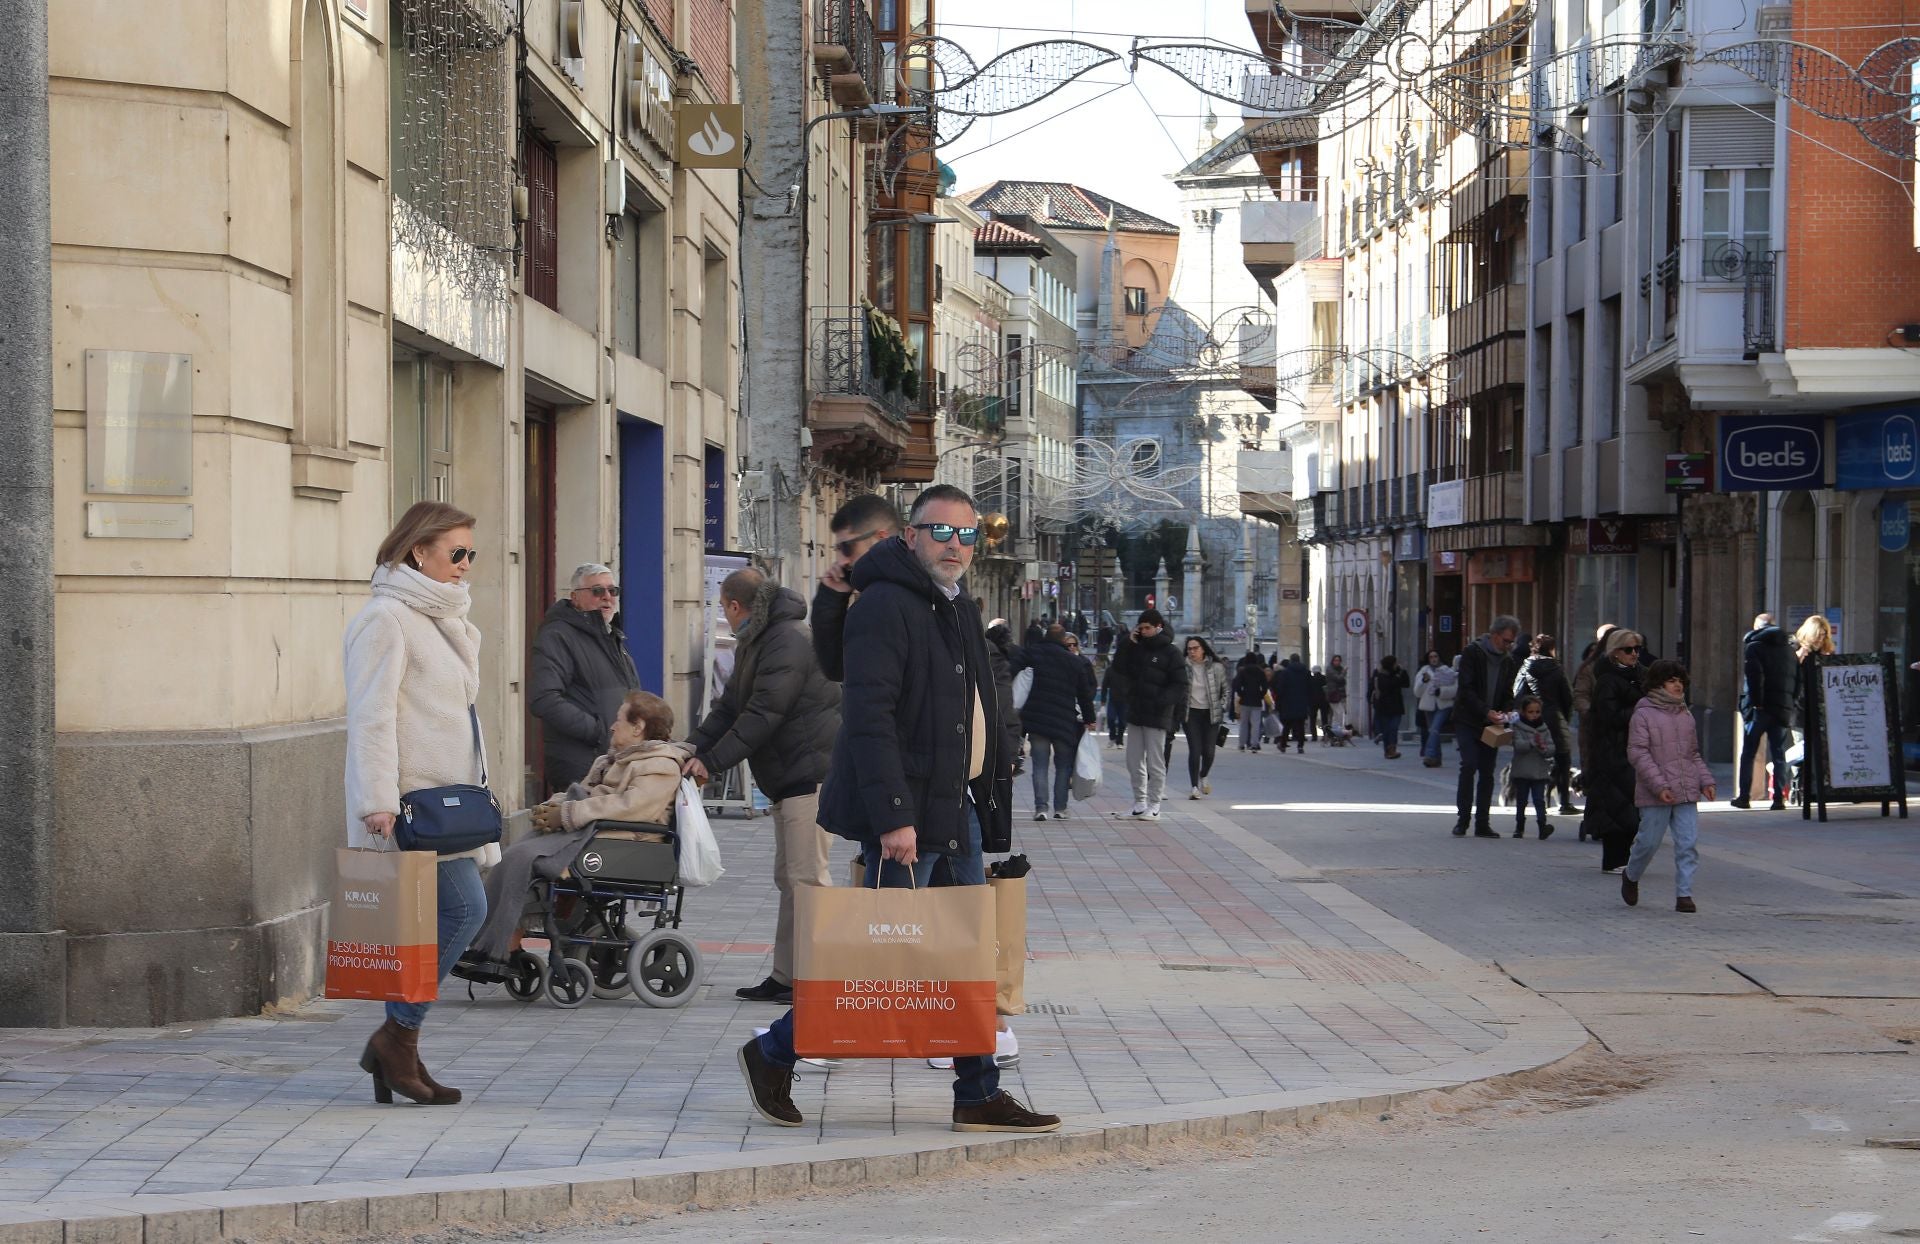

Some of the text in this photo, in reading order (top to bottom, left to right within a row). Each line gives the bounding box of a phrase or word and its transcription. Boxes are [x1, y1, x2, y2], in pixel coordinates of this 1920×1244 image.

[1740, 440, 1806, 467] bed's
[1350, 617, 1363, 628] 10
[1827, 671, 1840, 689] La
[344, 890, 380, 903] KRACK
[868, 923, 924, 936] KRACK
[333, 941, 396, 956] DESCUBRE TU
[329, 954, 403, 972] PROPIO CAMINO
[844, 979, 948, 994] DESCUBRE TU
[836, 996, 956, 1011] PROPIO CAMINO
